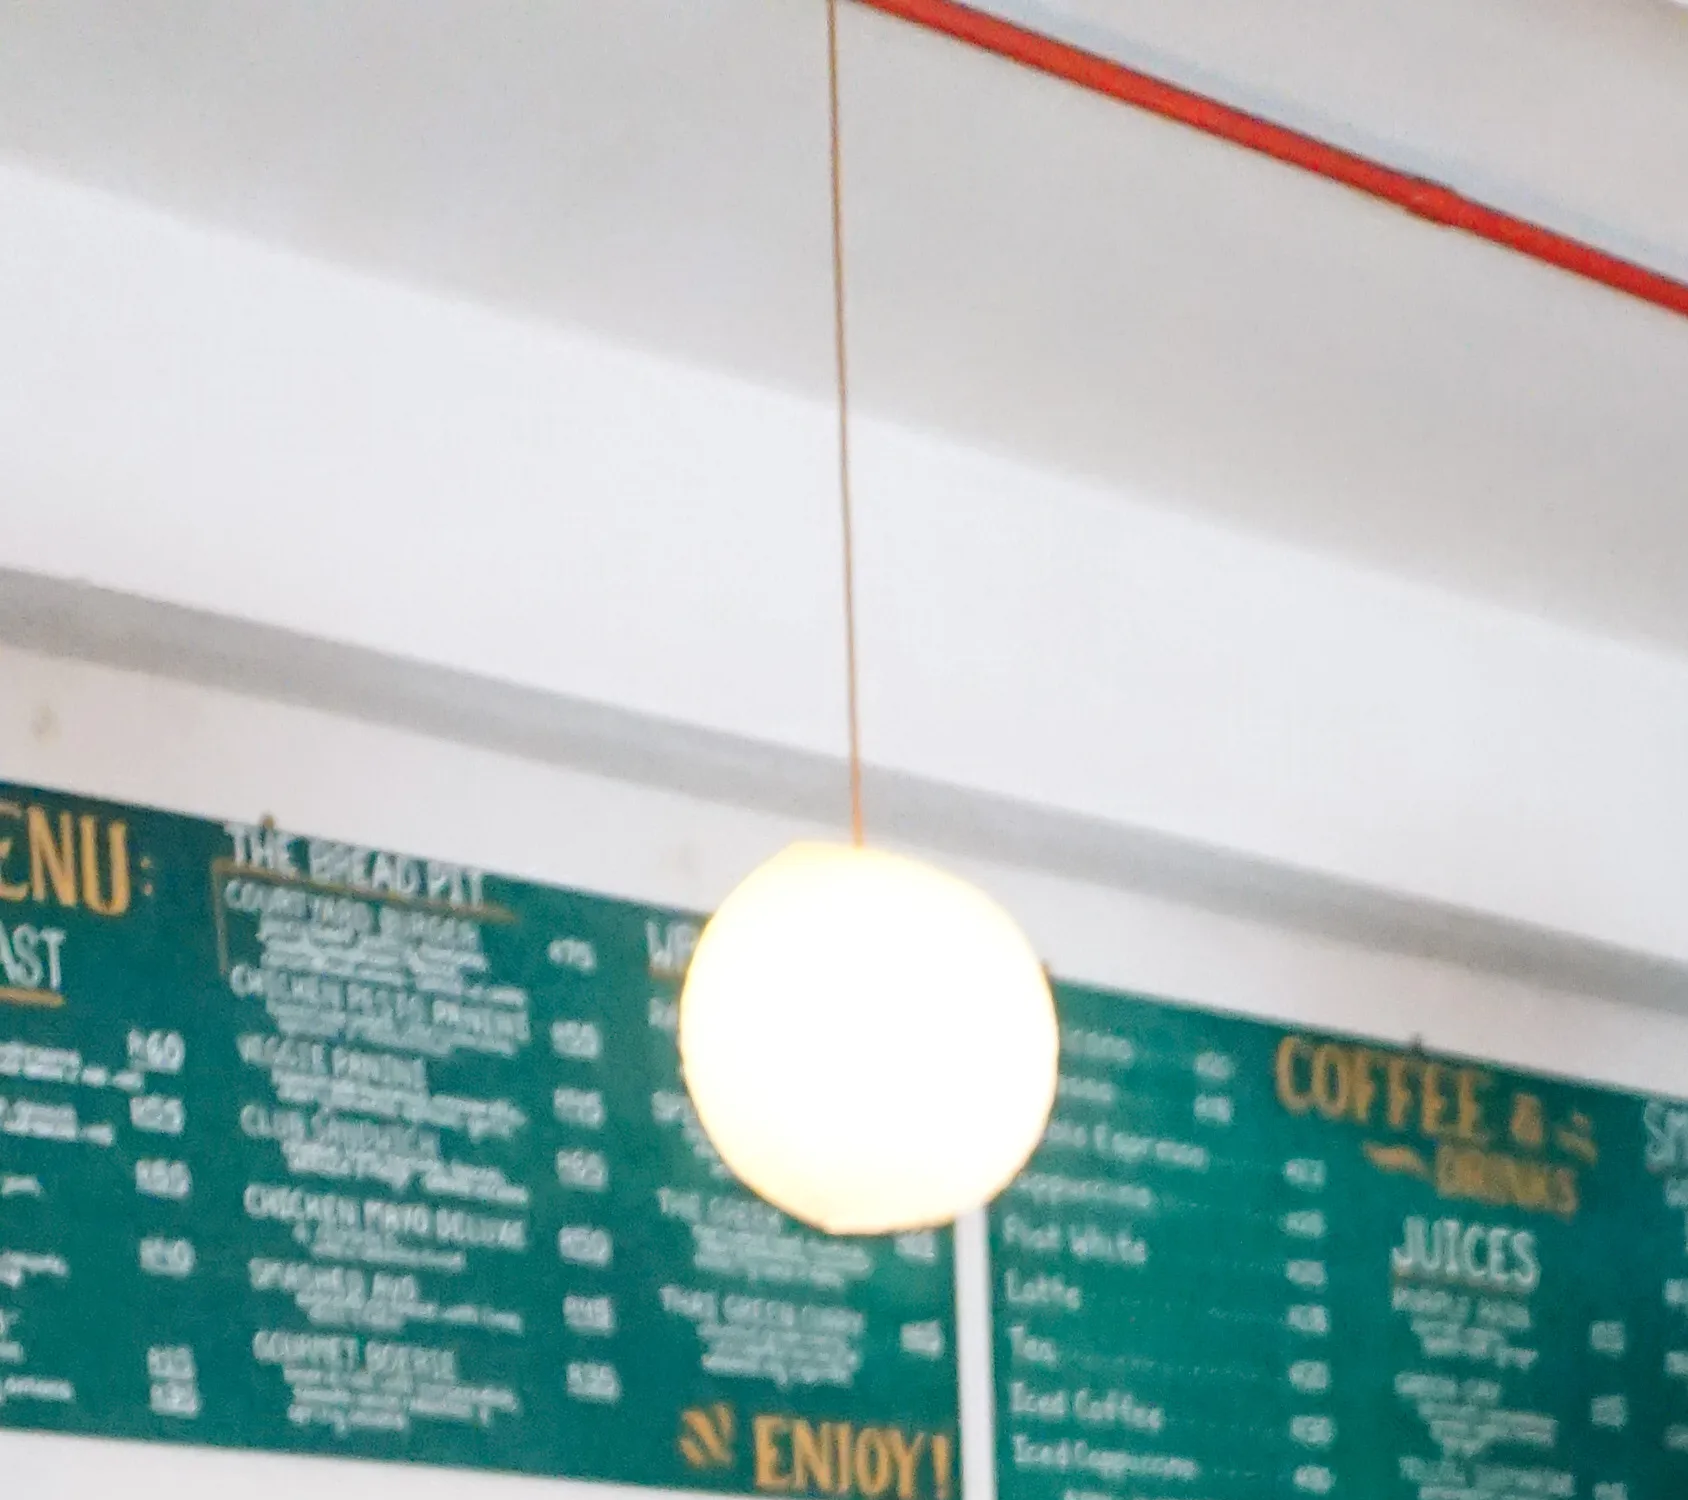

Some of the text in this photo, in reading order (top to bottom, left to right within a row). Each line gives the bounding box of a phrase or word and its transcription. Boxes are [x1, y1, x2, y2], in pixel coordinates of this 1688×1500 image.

[224, 824, 298, 877] THE
[307, 838, 421, 898] BREAD
[1274, 1034, 1492, 1141] COFFEE
[1391, 1215, 1542, 1291] JUICES
